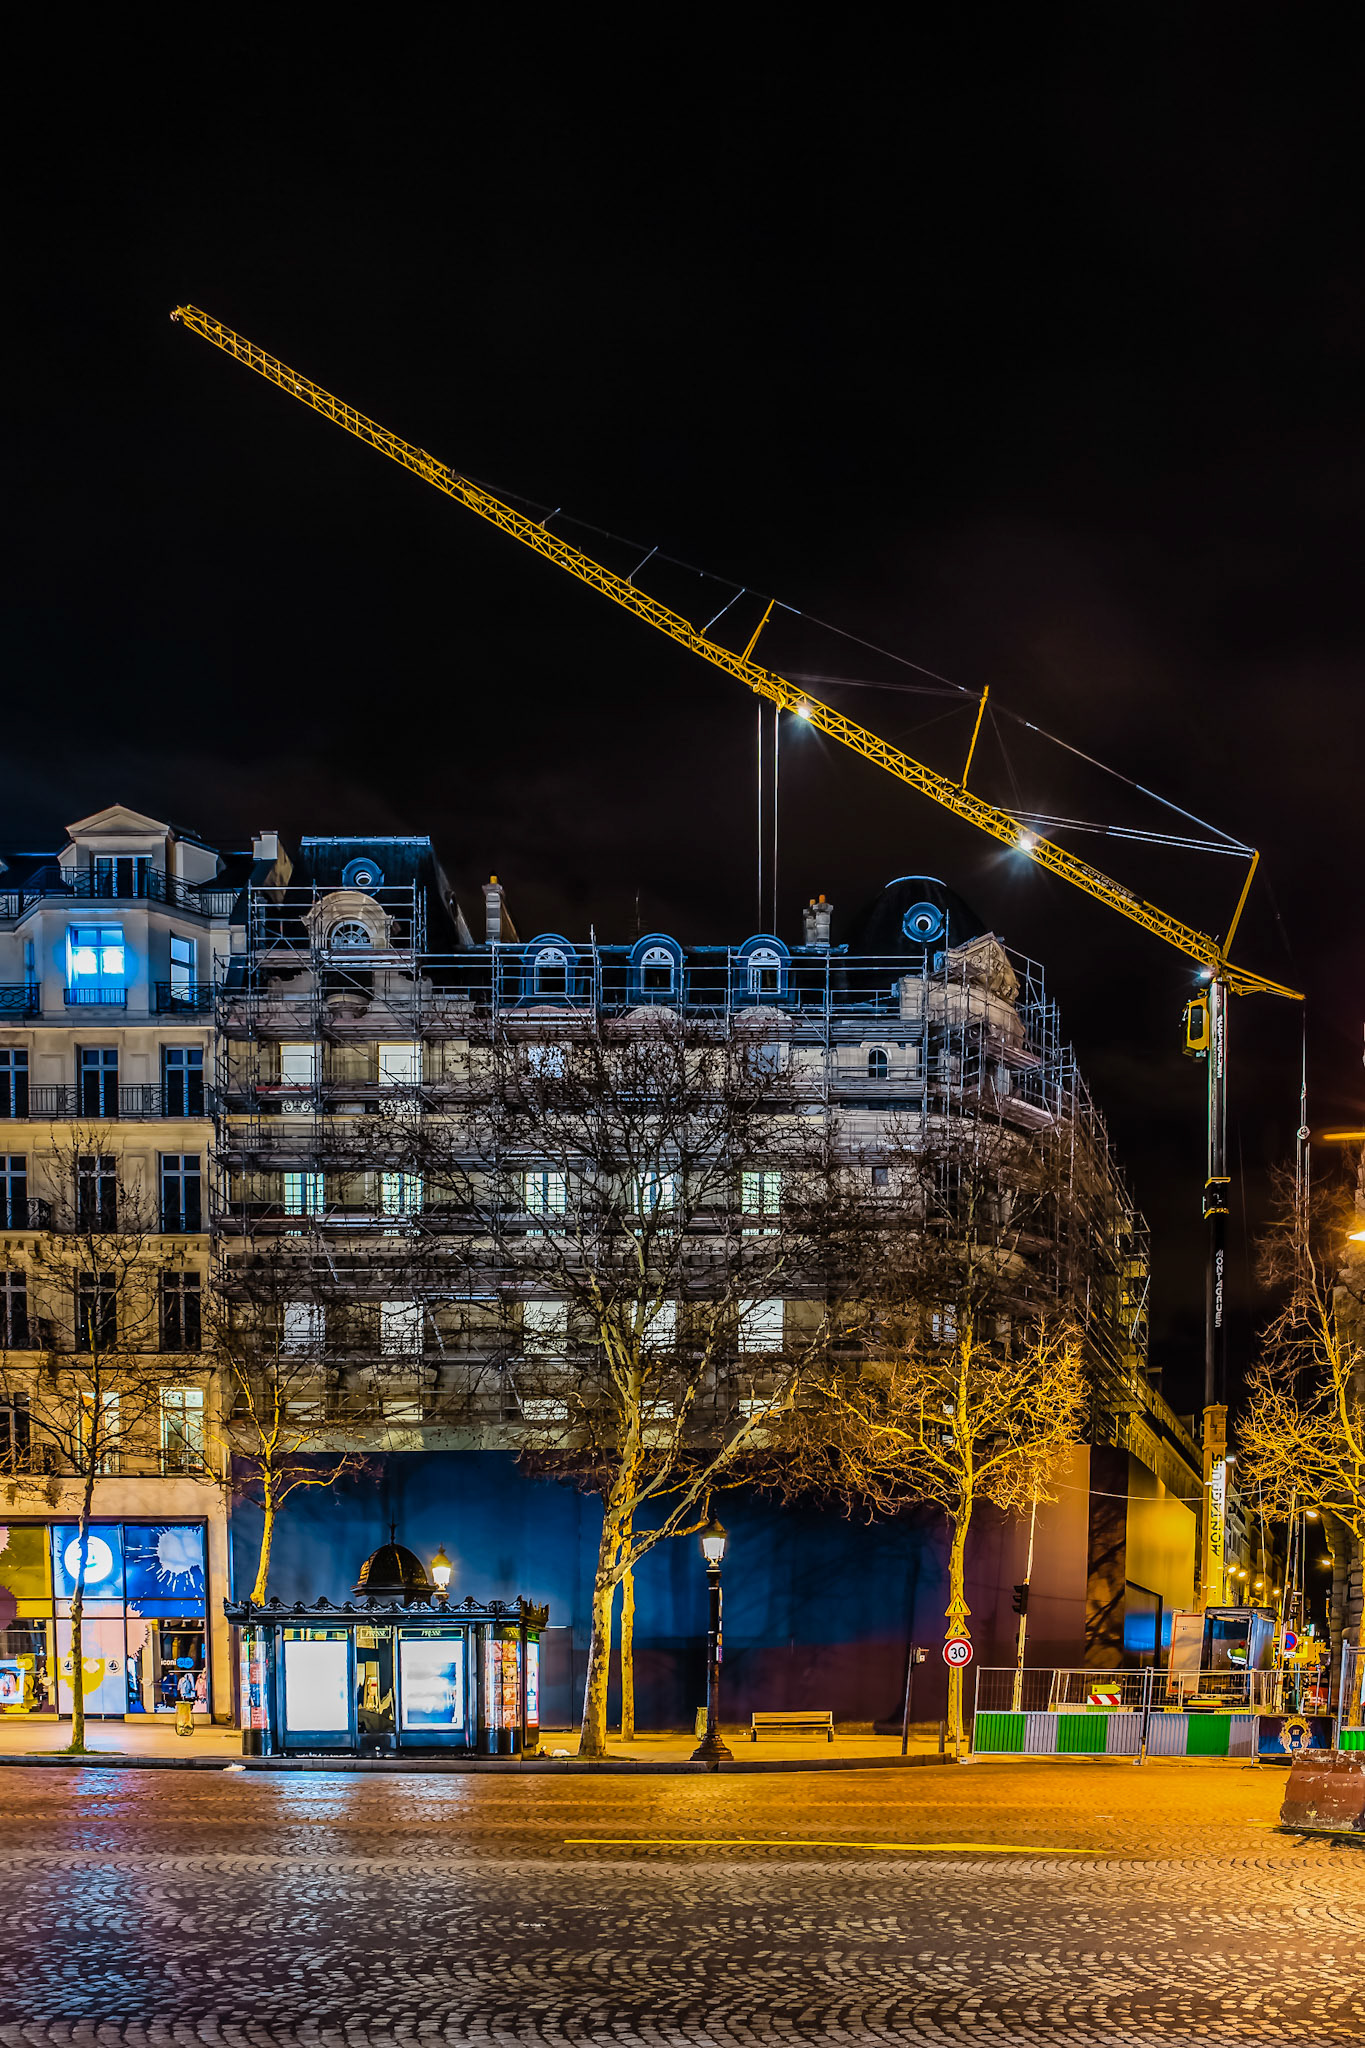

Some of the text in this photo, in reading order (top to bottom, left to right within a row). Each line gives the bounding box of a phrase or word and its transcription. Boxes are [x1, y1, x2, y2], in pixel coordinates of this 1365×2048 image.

[1215, 1249, 1224, 1328] MONTAGRUES
[1210, 1451, 1223, 1557] MONTAGRUES
[950, 1646, 967, 1660] 30
